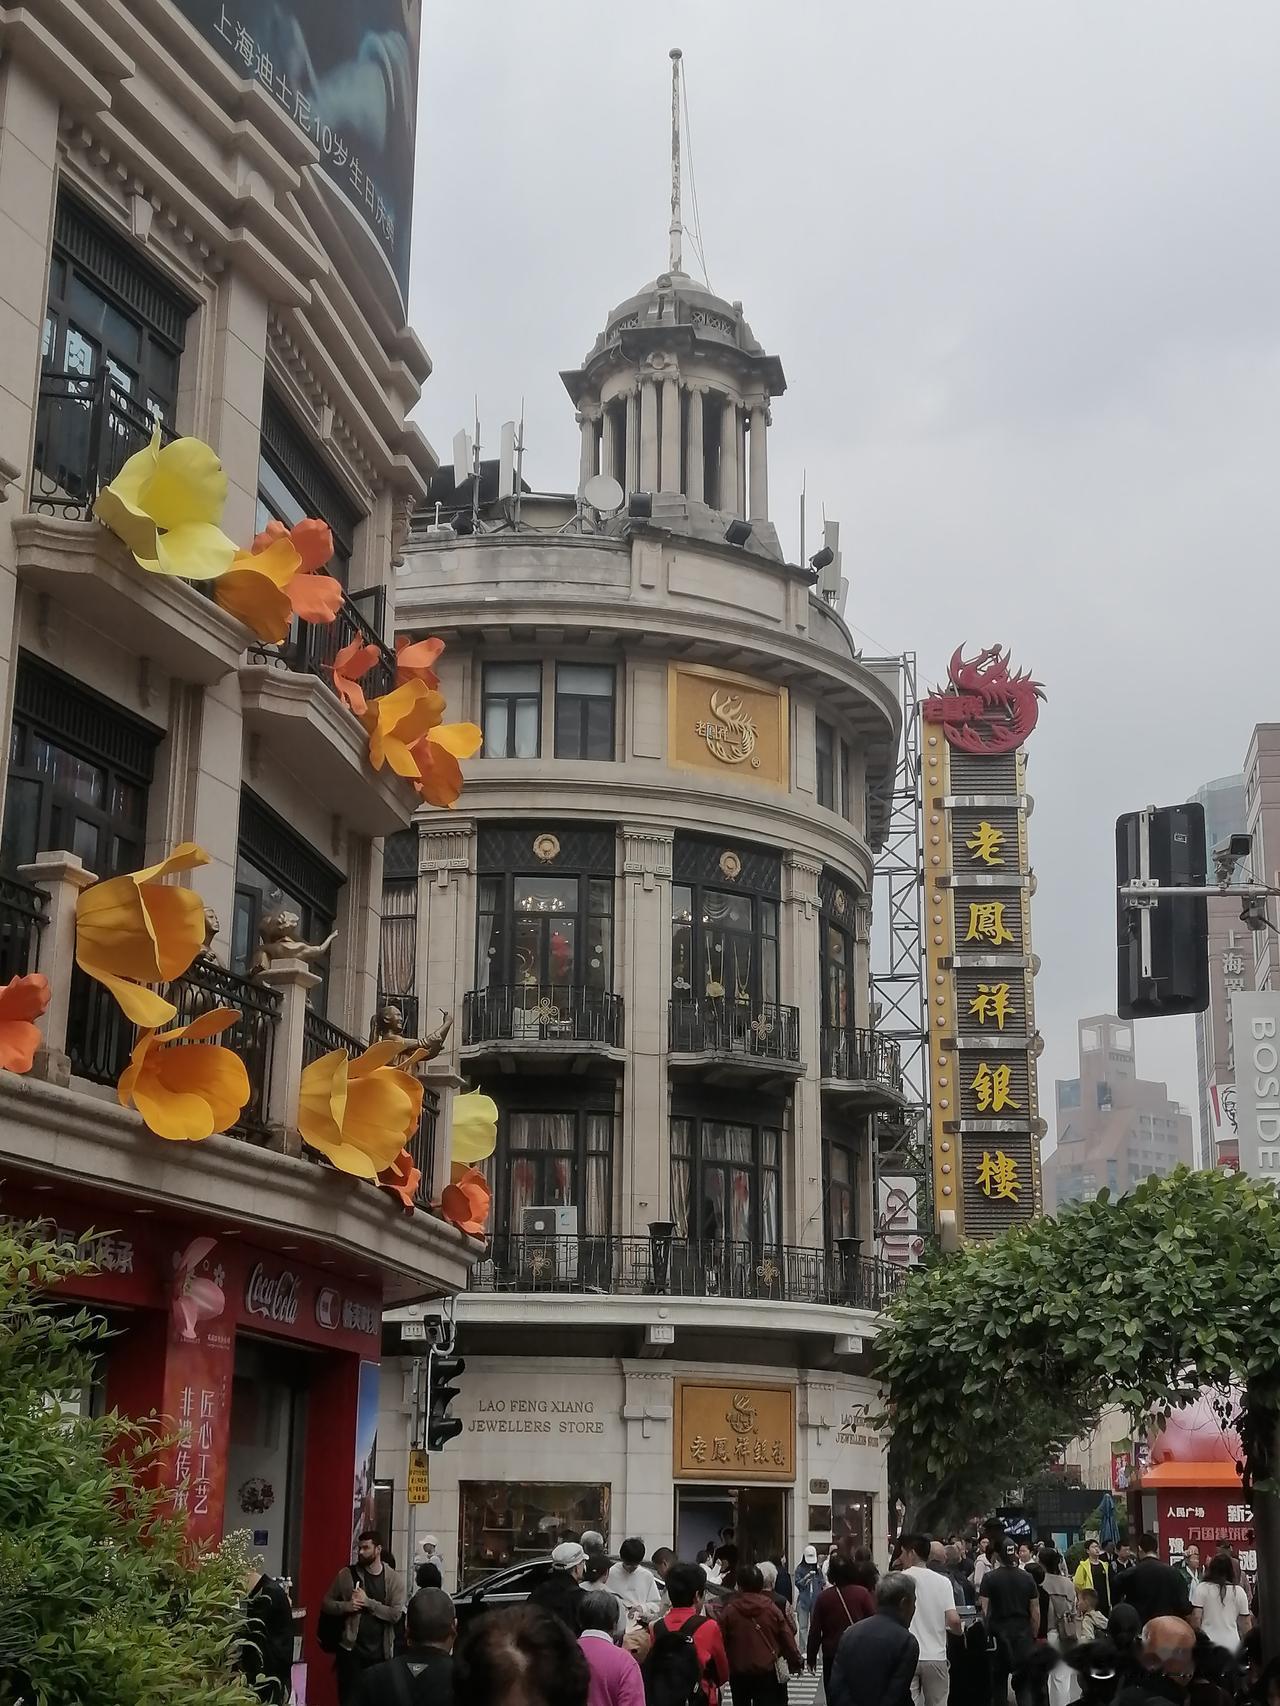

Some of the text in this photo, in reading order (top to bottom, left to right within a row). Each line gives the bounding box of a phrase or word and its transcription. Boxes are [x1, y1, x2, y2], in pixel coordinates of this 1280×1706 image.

[963, 821, 1023, 1203] 老鳳祥銀樓
[1222, 929, 1246, 1071] 上海置
[1251, 1017, 1280, 1184] BOSIDE
[194, 1389, 216, 1514] 匠心工艺
[468, 1420, 604, 1433] JEWELLERS STORE
[479, 1400, 594, 1413] LAO FENG XIANG
[1167, 1506, 1205, 1518] 人民广场
